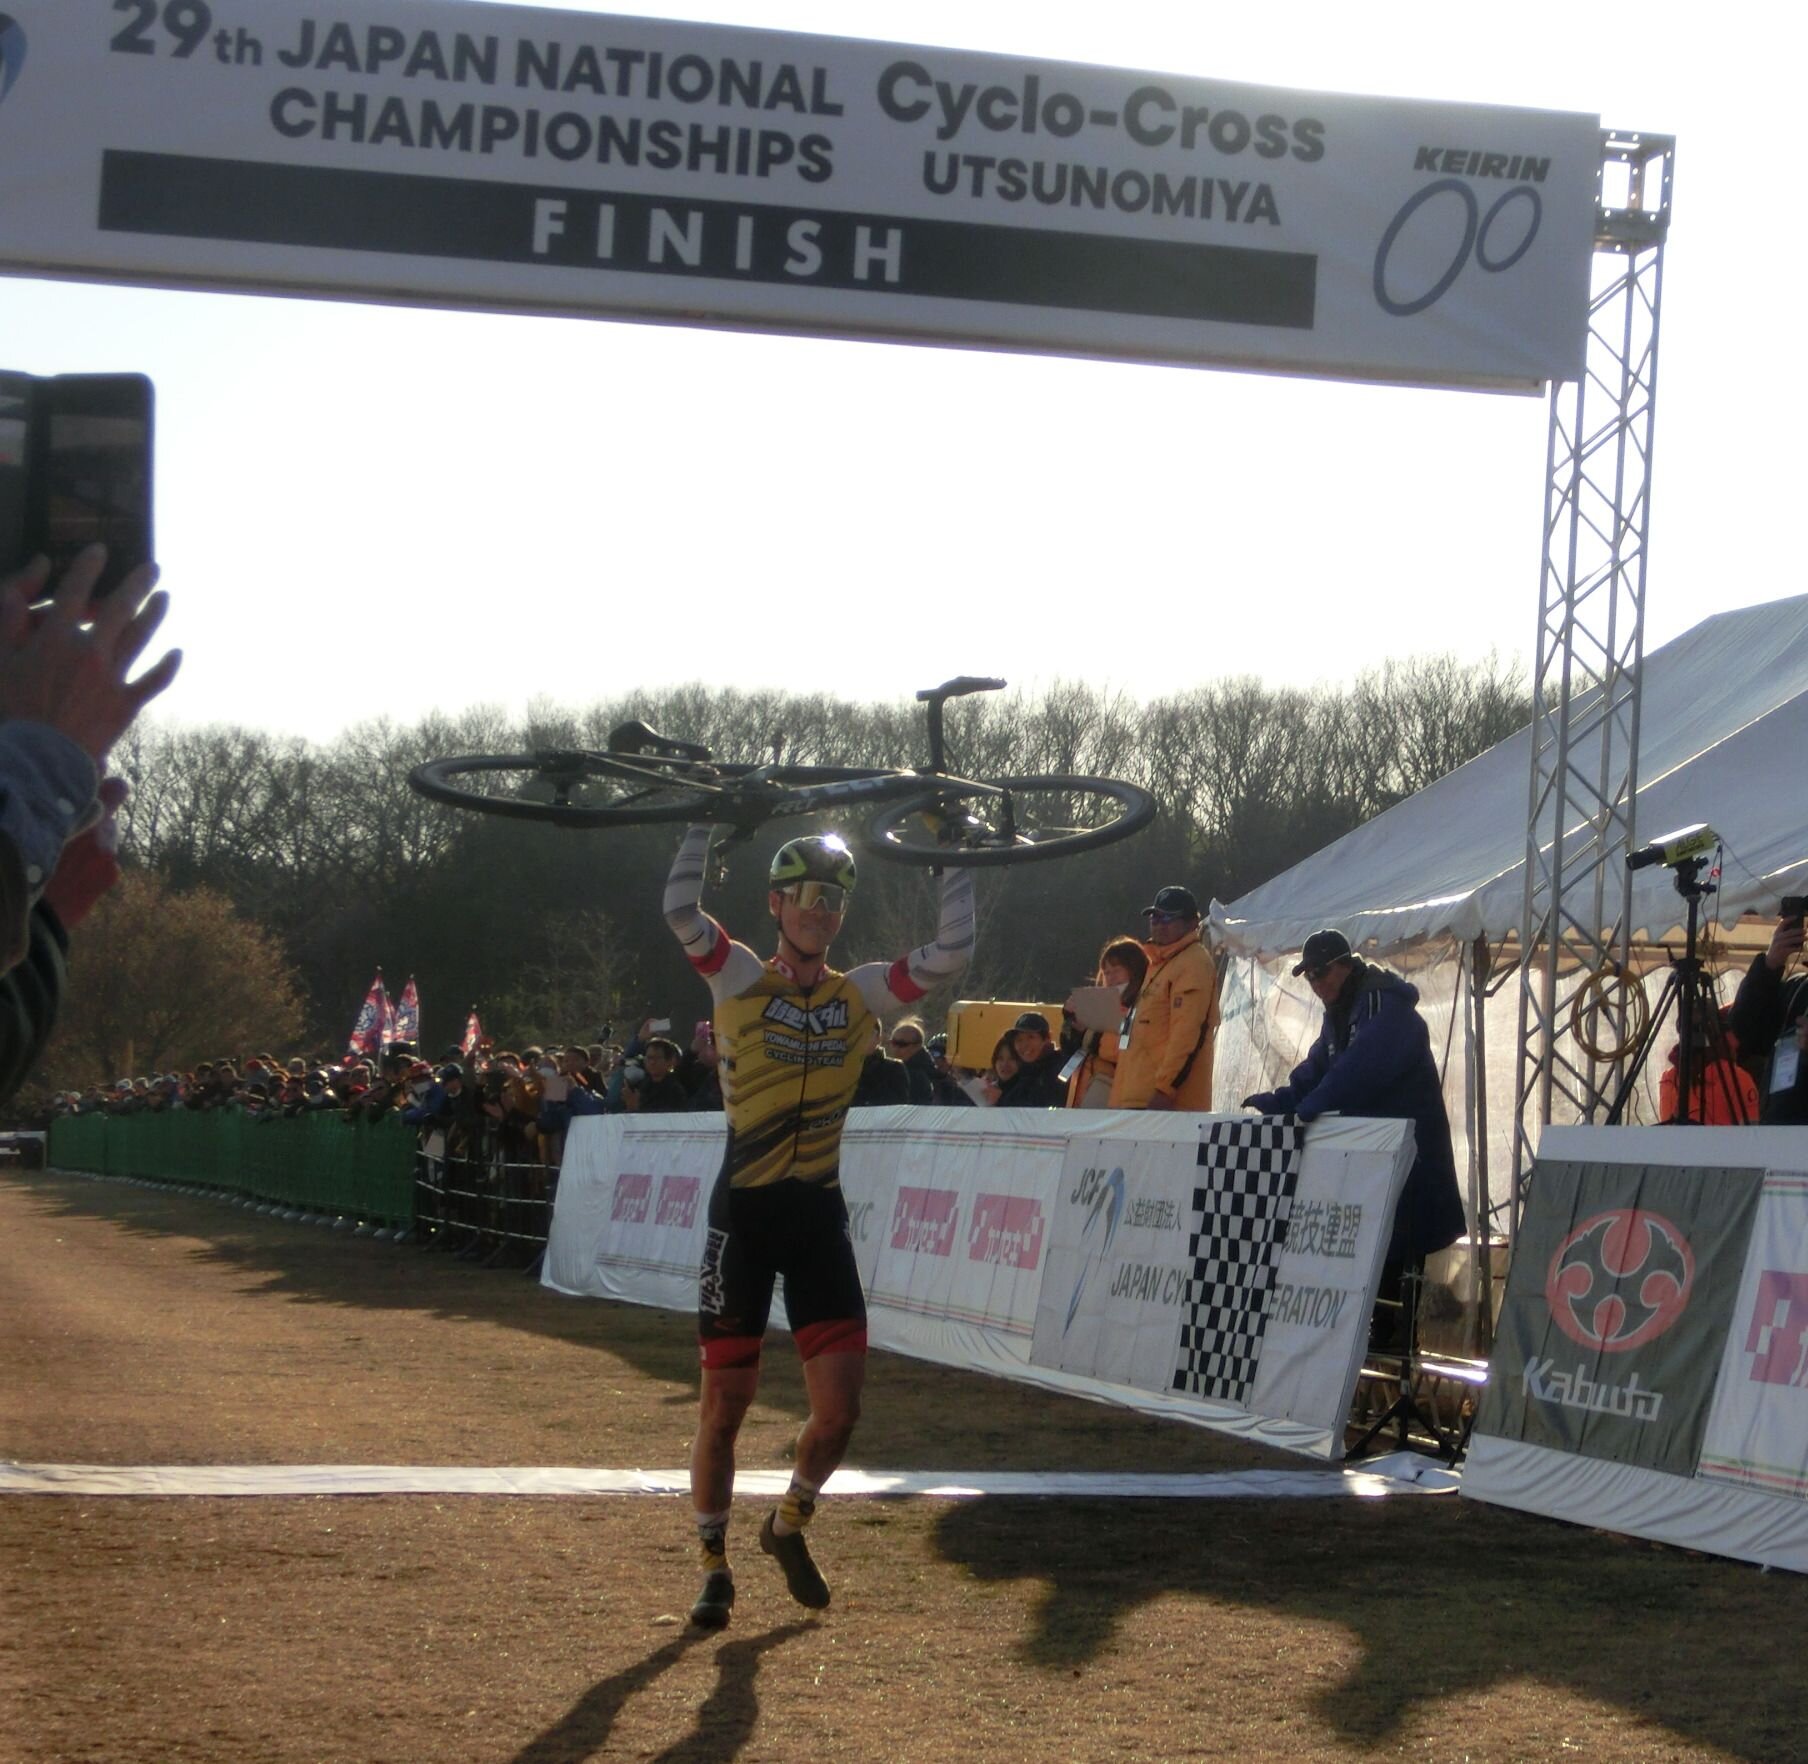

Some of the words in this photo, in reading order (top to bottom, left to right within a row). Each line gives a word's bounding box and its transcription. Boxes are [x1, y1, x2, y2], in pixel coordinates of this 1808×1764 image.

[110, 0, 263, 66] 29th
[277, 19, 498, 85] JAPAN
[516, 39, 844, 117] NATIONAL
[270, 87, 834, 184] CHAMPIONSHIPS
[876, 60, 1326, 163] Cyclo-Cross
[923, 150, 1281, 227] UTSUNOMIYA
[1413, 146, 1552, 183] KEIRIN
[532, 199, 902, 284] FINISH
[1283, 1199, 1362, 1259] 競技連盟
[1111, 1262, 1163, 1300] JAPAN
[1267, 1282, 1348, 1329] ERATION
[1523, 1355, 1664, 1422] Kabuto
